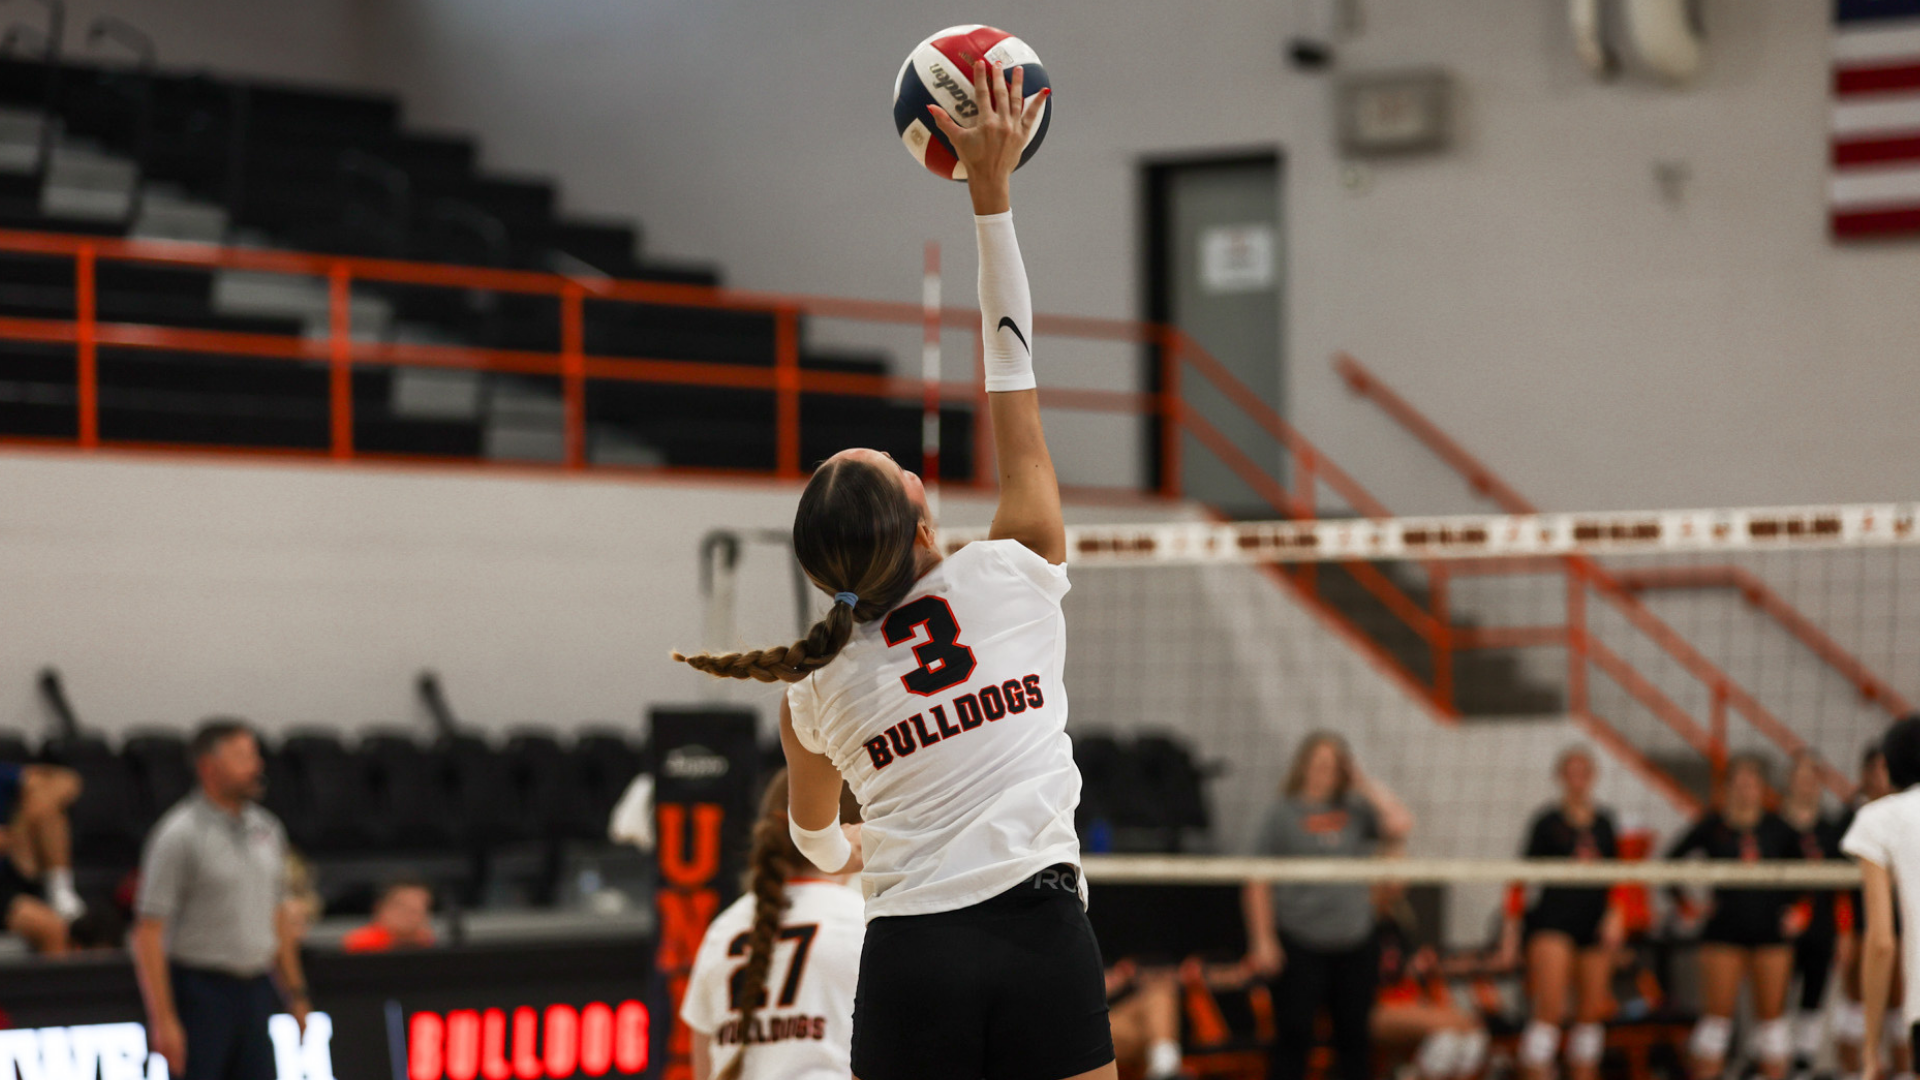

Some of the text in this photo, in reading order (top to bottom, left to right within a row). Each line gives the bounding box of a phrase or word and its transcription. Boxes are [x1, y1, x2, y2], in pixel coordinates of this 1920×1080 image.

[929, 63, 979, 119] Baden
[880, 595, 977, 697] 3
[863, 673, 1044, 770] BULLDOGS
[727, 921, 820, 1012] 27
[717, 1013, 827, 1045] BULDOGS
